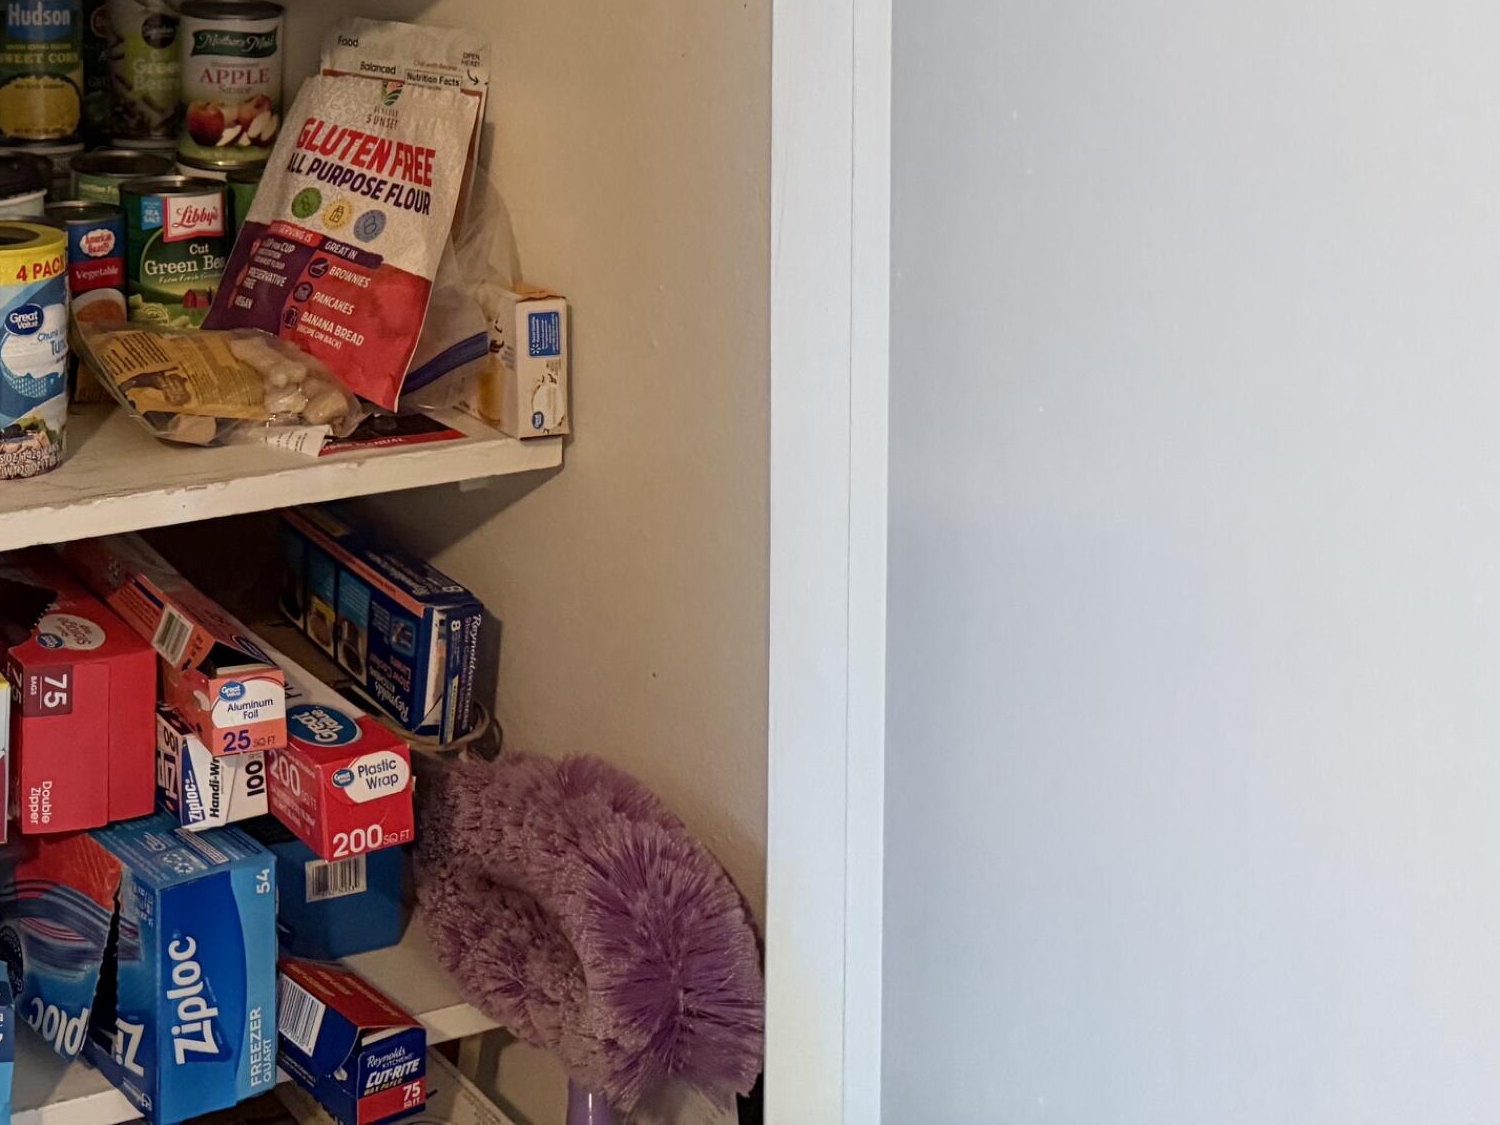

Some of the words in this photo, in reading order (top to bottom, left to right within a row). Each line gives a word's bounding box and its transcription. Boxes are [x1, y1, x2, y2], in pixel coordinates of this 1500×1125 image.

[8, 1, 71, 27] Hudson
[337, 35, 359, 48] Food
[199, 68, 270, 85] APPLE
[360, 61, 397, 75] Balanced
[406, 72, 438, 85] Nutrition
[438, 75, 460, 87] Facts
[296, 117, 393, 174] GLUTEN
[388, 142, 437, 188] FREE
[305, 157, 389, 200] PURPOSE
[383, 182, 432, 216] FLOUR
[172, 204, 219, 229] Libby's
[189, 243, 210, 255] Cut
[280, 242, 297, 254] CUP
[324, 241, 350, 258] GREAT
[349, 249, 359, 260] IN
[16, 265, 29, 282] 4
[144, 259, 198, 276] Green
[203, 255, 226, 270] Bea
[328, 266, 372, 289] BROWNIES
[312, 291, 356, 316] PANCAKES
[9, 311, 39, 324] Great
[300, 311, 335, 334] BANANA
[334, 321, 365, 347] BREAD
[451, 620, 462, 632] 8
[30, 676, 38, 696] BAGS
[43, 674, 68, 709] 75
[227, 697, 274, 713] Aluminum
[243, 708, 259, 720] Foil
[291, 711, 339, 743] Great
[222, 729, 252, 753] 25
[267, 735, 276, 745] FT
[245, 760, 265, 798] 100
[268, 749, 301, 796] 200
[357, 758, 398, 778] Plastic
[209, 755, 221, 818] Handi-Wr
[365, 774, 399, 791] Wrap
[30, 786, 42, 825] Zipper
[42, 780, 53, 824] Double
[332, 823, 383, 858] 200
[383, 832, 398, 845] SQ
[400, 829, 411, 841] FT
[256, 868, 271, 895] 54
[166, 935, 221, 1065] Ziploc
[250, 1006, 262, 1088] FREEZER
[366, 1045, 406, 1068] Reynolds
[262, 1037, 273, 1083] QUART
[365, 1058, 421, 1089] CUT-RITE
[402, 1081, 421, 1101] 75
